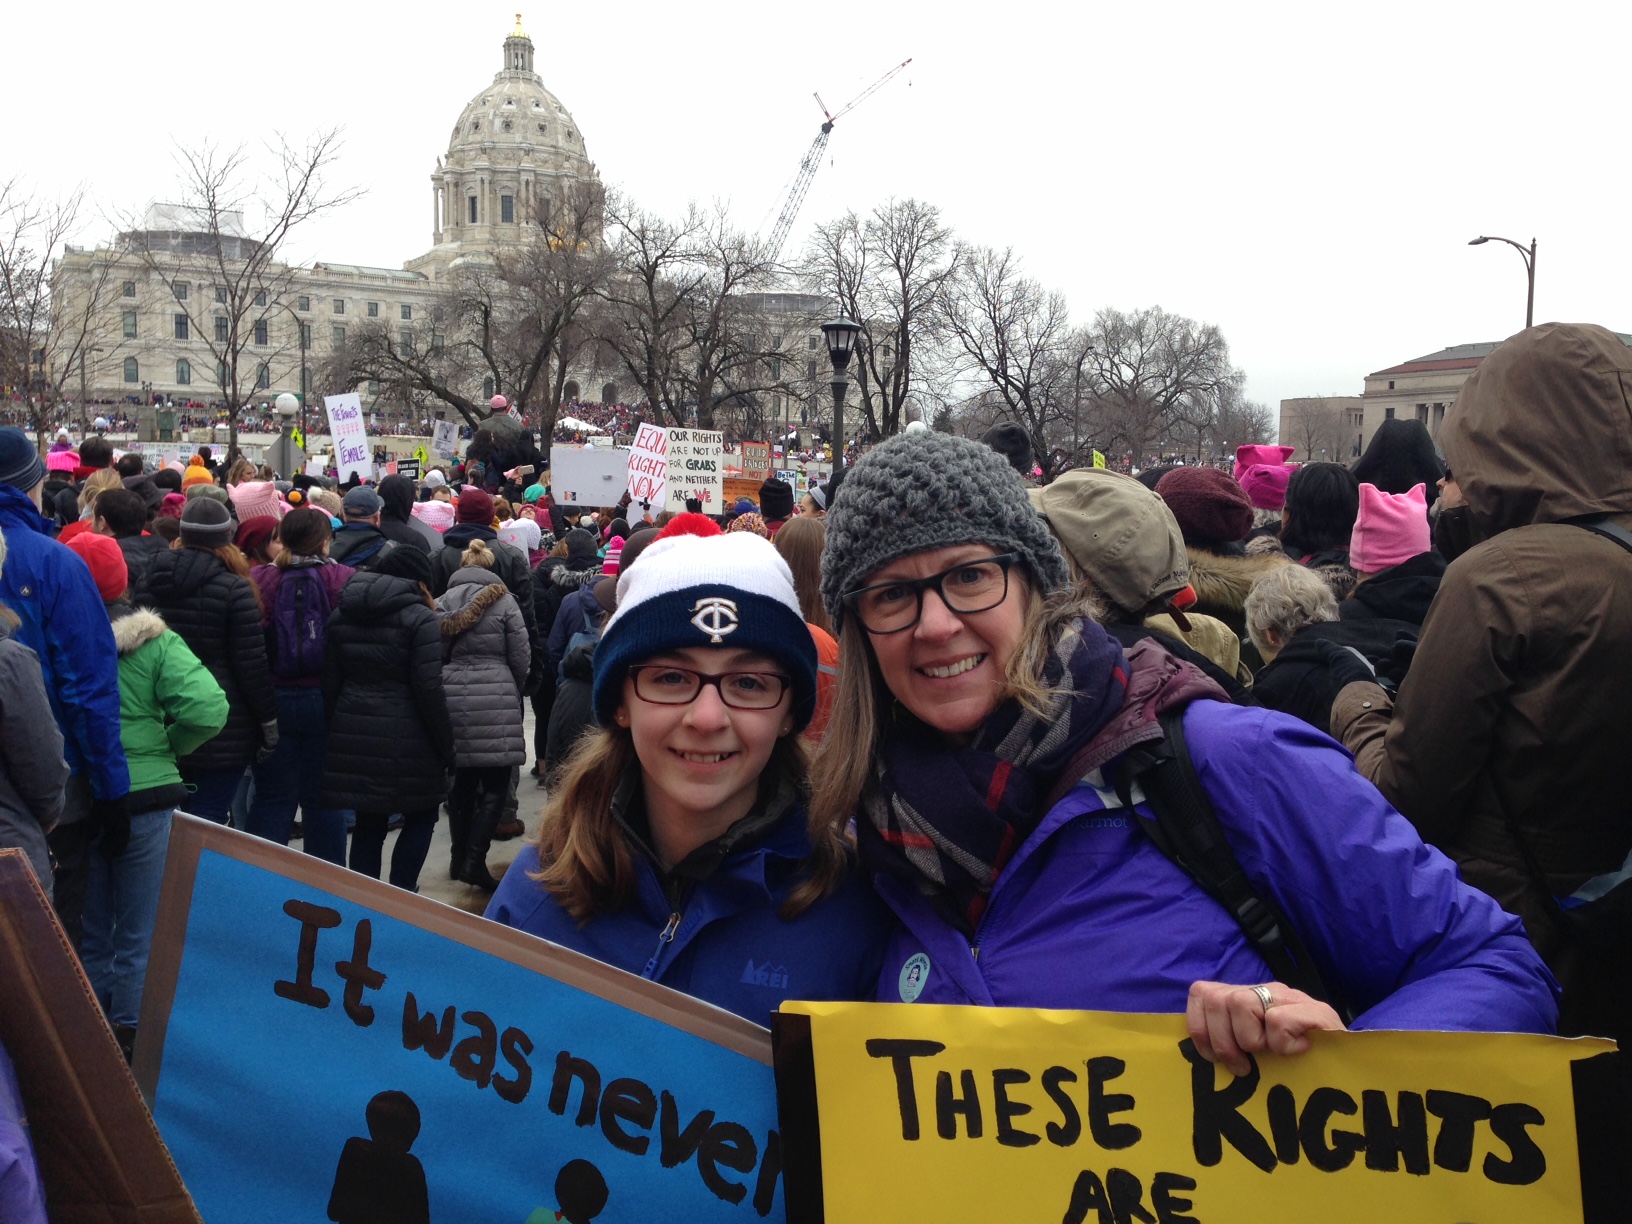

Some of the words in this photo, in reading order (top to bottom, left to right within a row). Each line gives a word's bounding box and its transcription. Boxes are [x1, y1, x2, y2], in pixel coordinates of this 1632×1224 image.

[636, 427, 666, 456] EQU
[669, 430, 689, 442] OUR
[692, 431, 722, 444] RIGHTS
[339, 438, 365, 466] FEMALE
[670, 446, 688, 456] ARE
[693, 446, 709, 456] NOT
[712, 447, 721, 456] UP
[746, 447, 767, 458] BUILD
[628, 453, 666, 480] RIGHT
[669, 459, 683, 469] FOR
[686, 459, 716, 472] GRABS
[744, 459, 769, 471] BRIDGES
[669, 475, 683, 484] AND
[686, 475, 718, 485] NEITHER
[748, 471, 762, 479] NOT
[628, 474, 664, 501] NOW
[672, 489, 690, 502] ARE
[693, 487, 711, 503] WE
[273, 899, 387, 1027] It
[402, 991, 534, 1103] was
[865, 1038, 1142, 1151] THESE
[1179, 1038, 1547, 1185] RIGHTS
[1063, 1168, 1198, 1224] ARE
